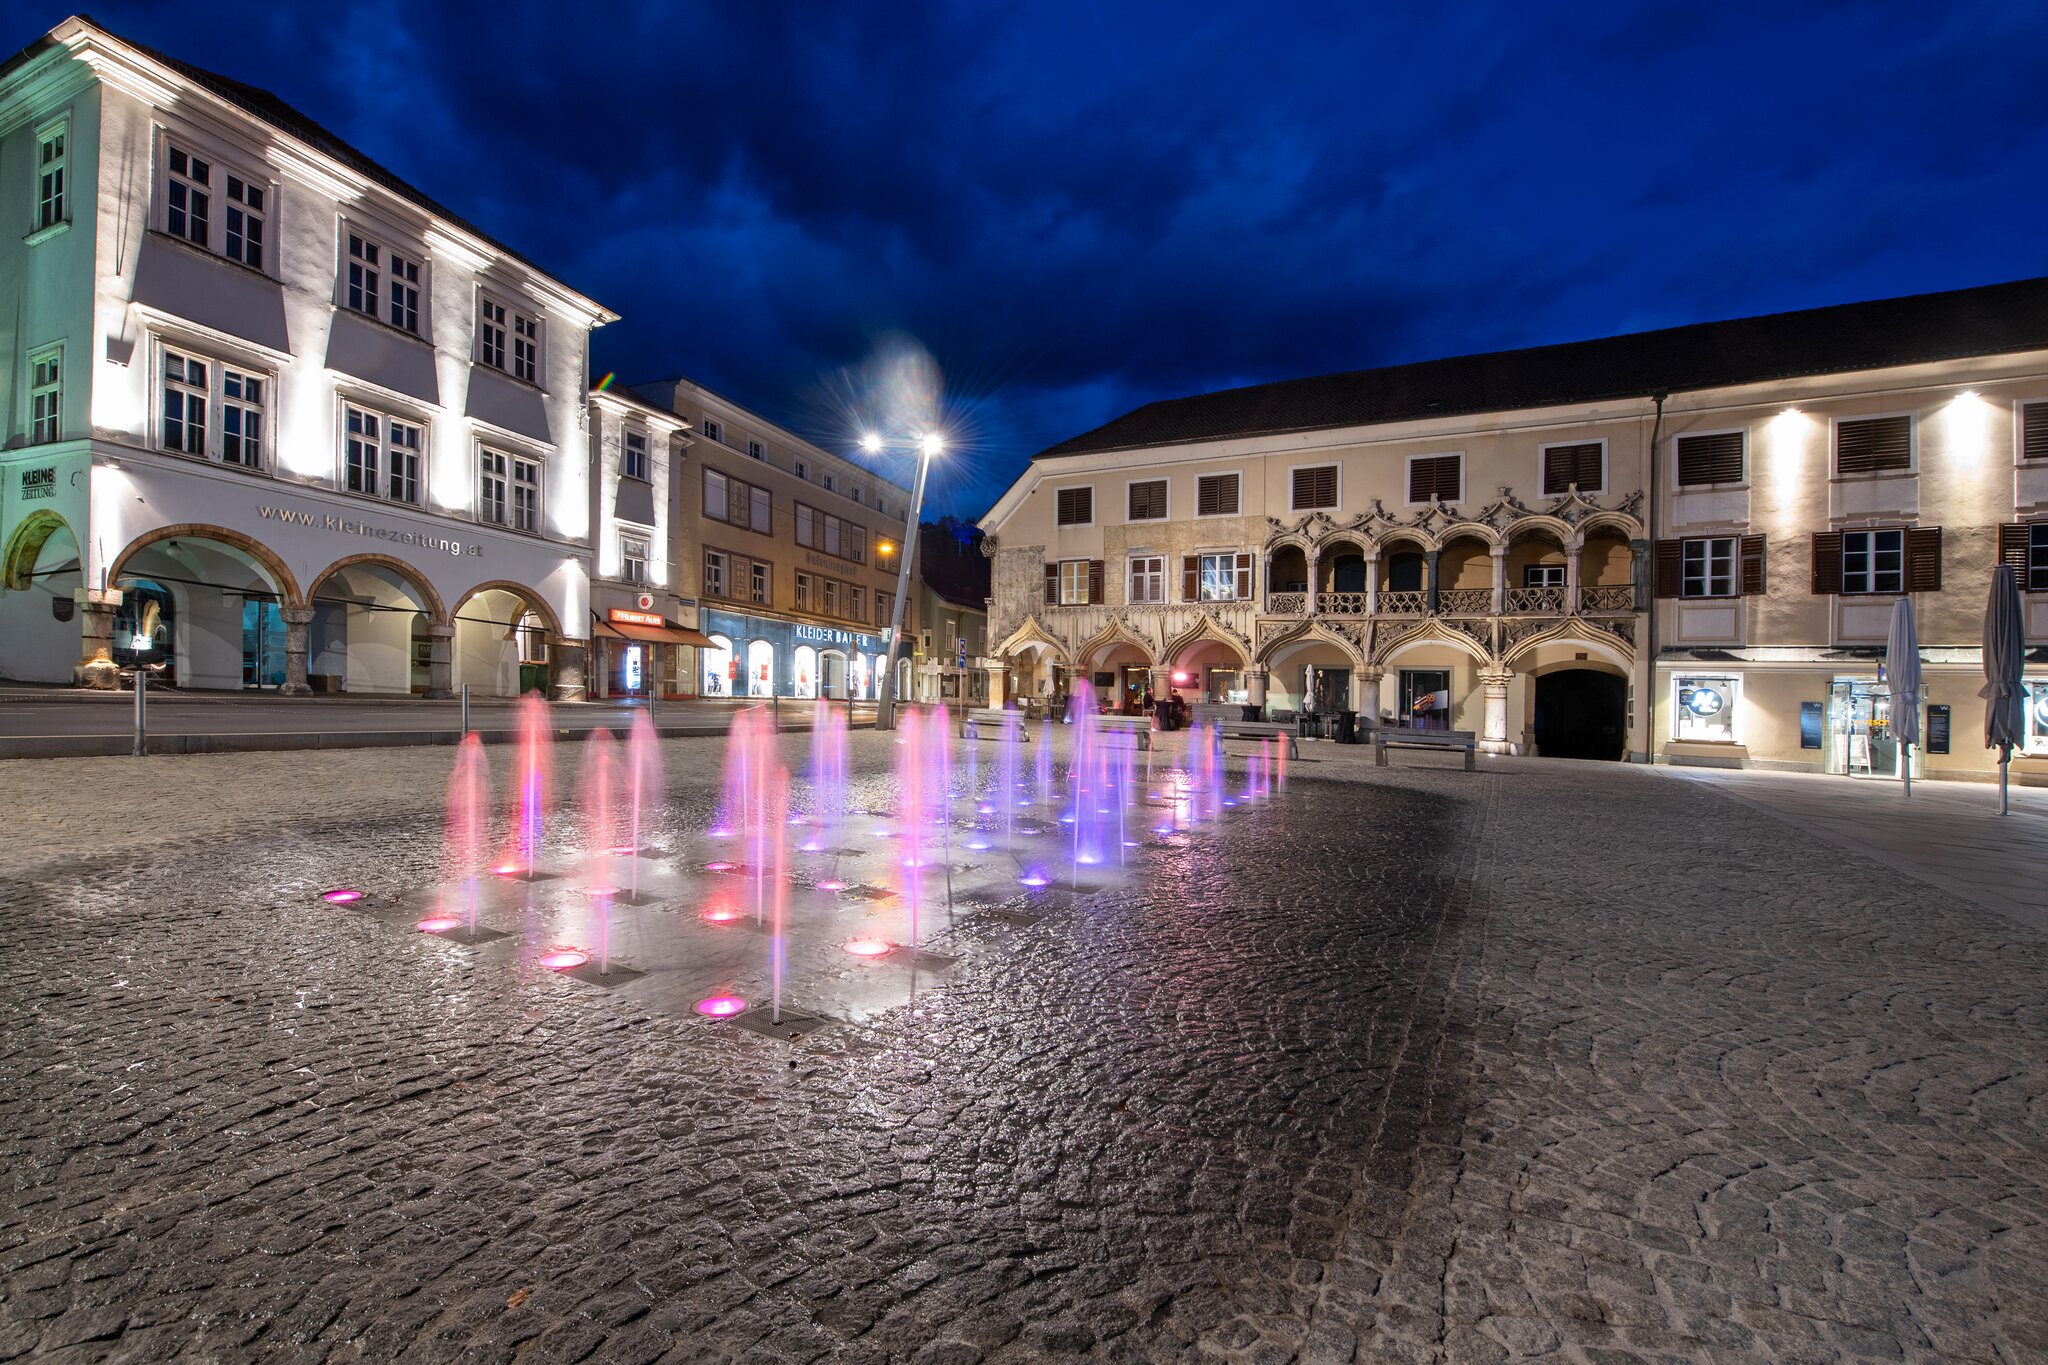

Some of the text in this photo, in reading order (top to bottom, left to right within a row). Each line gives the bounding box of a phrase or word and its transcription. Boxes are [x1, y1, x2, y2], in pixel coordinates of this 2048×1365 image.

[22, 468, 55, 485] KLEINE
[22, 487, 55, 500] ZEITUNG
[259, 505, 483, 557] www.kleinezeitung.at
[796, 625, 833, 642] KLEIDER
